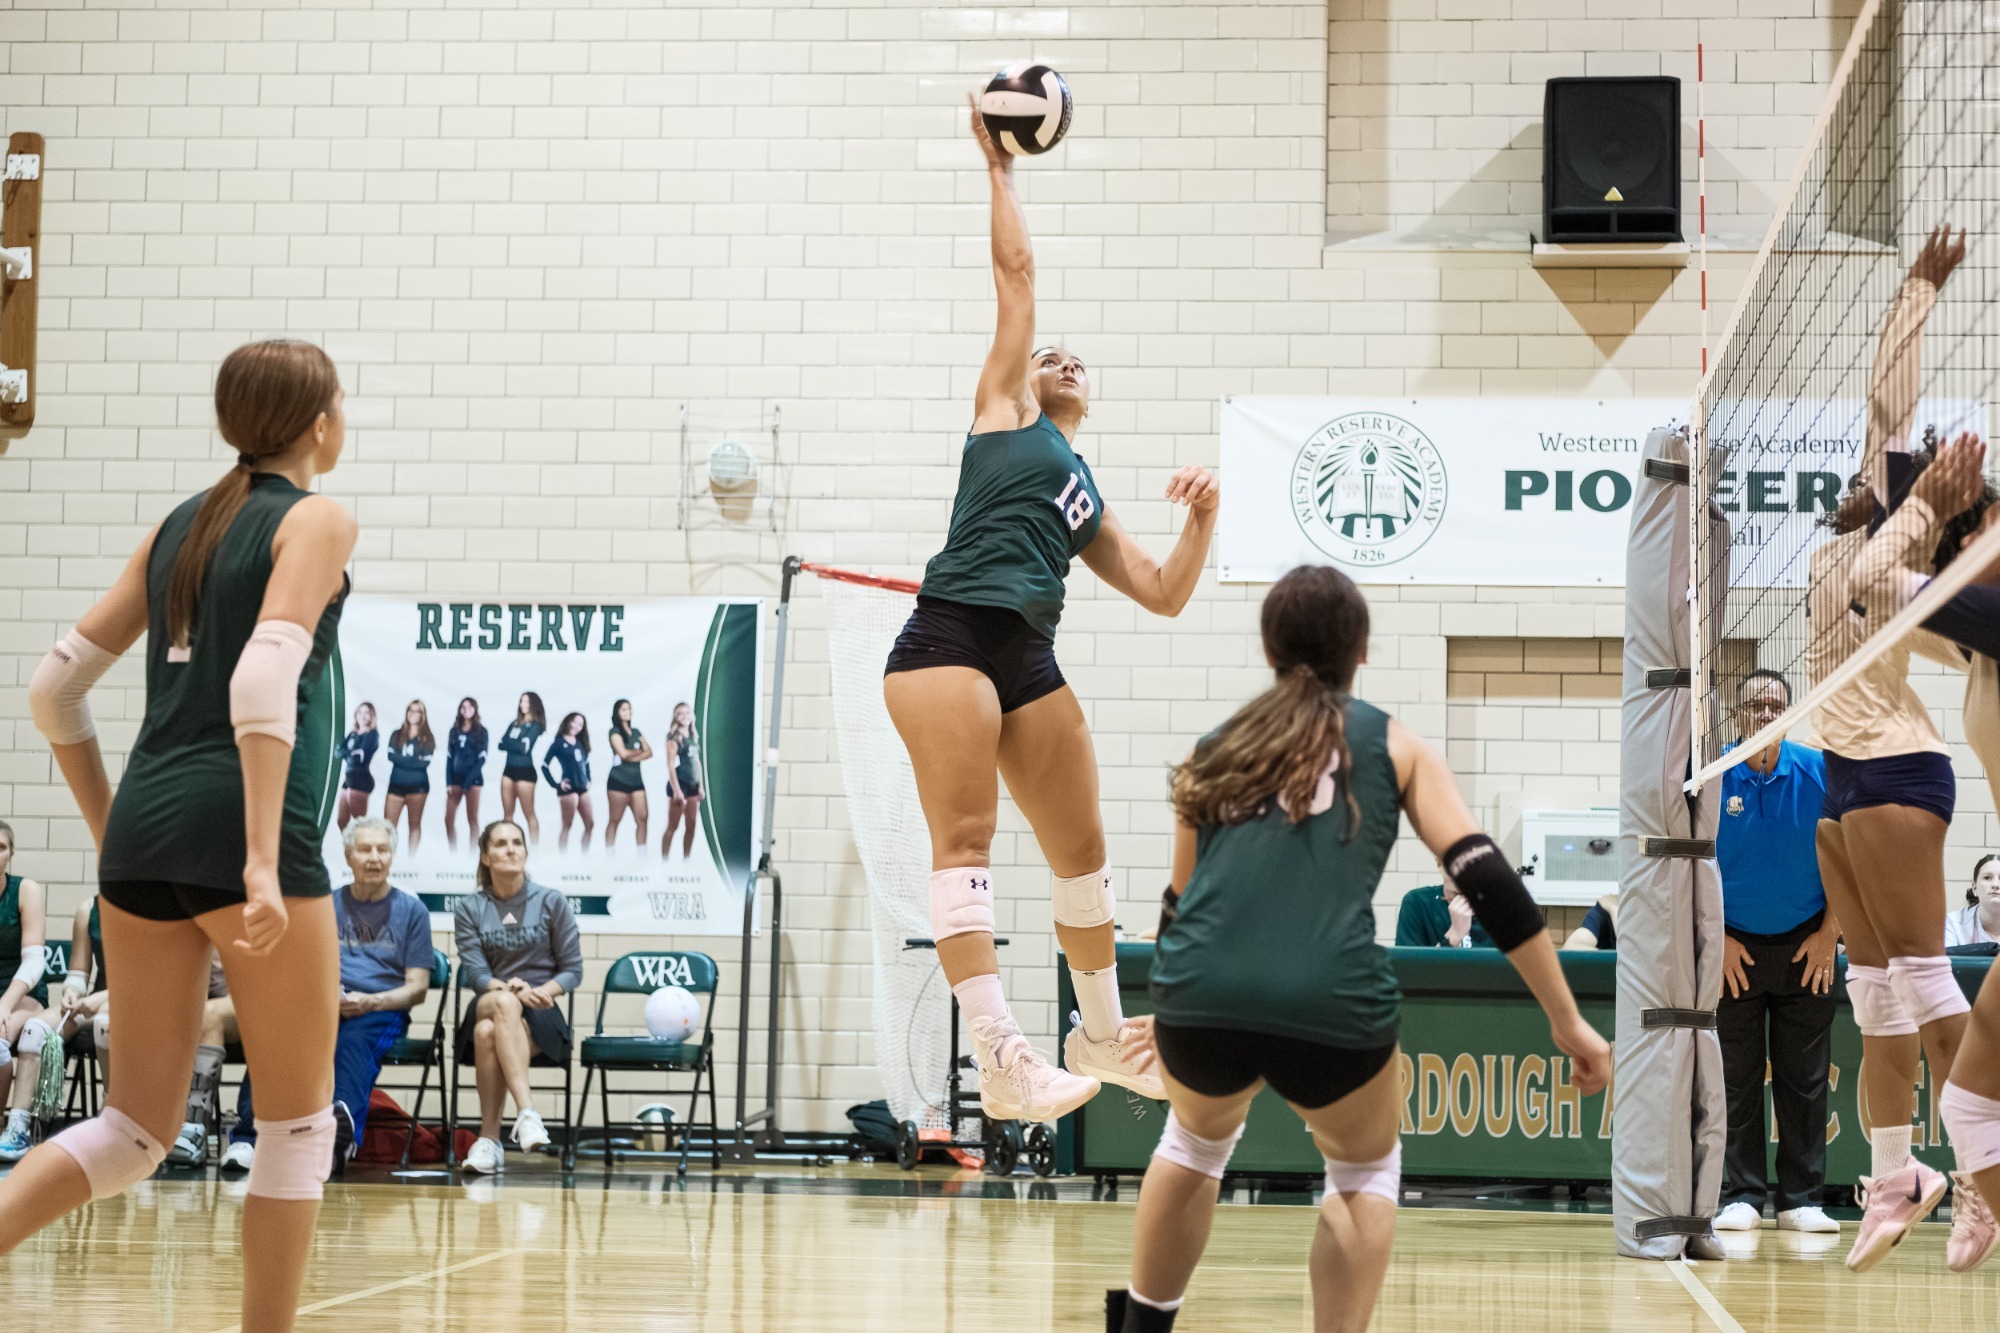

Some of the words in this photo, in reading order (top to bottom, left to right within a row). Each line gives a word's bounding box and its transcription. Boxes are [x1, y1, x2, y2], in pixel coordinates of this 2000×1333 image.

[1538, 432, 1638, 453] Western
[1749, 433, 1861, 459] Academy
[1296, 438, 1326, 524] WESTERN
[1326, 416, 1409, 441] RESERVE
[1409, 437, 1443, 526] ACADEMY
[1054, 472, 1095, 531] 18
[1342, 483, 1361, 492] LUX
[1375, 483, 1397, 492] VERI
[1504, 469, 1862, 513] PIOEER
[1352, 549, 1385, 562] 1826
[416, 603, 625, 652] RESERVE
[647, 891, 707, 920] WRA
[43, 944, 69, 975] RA
[627, 955, 697, 987] WRA
[1400, 1053, 1583, 1139] RDOUGH
